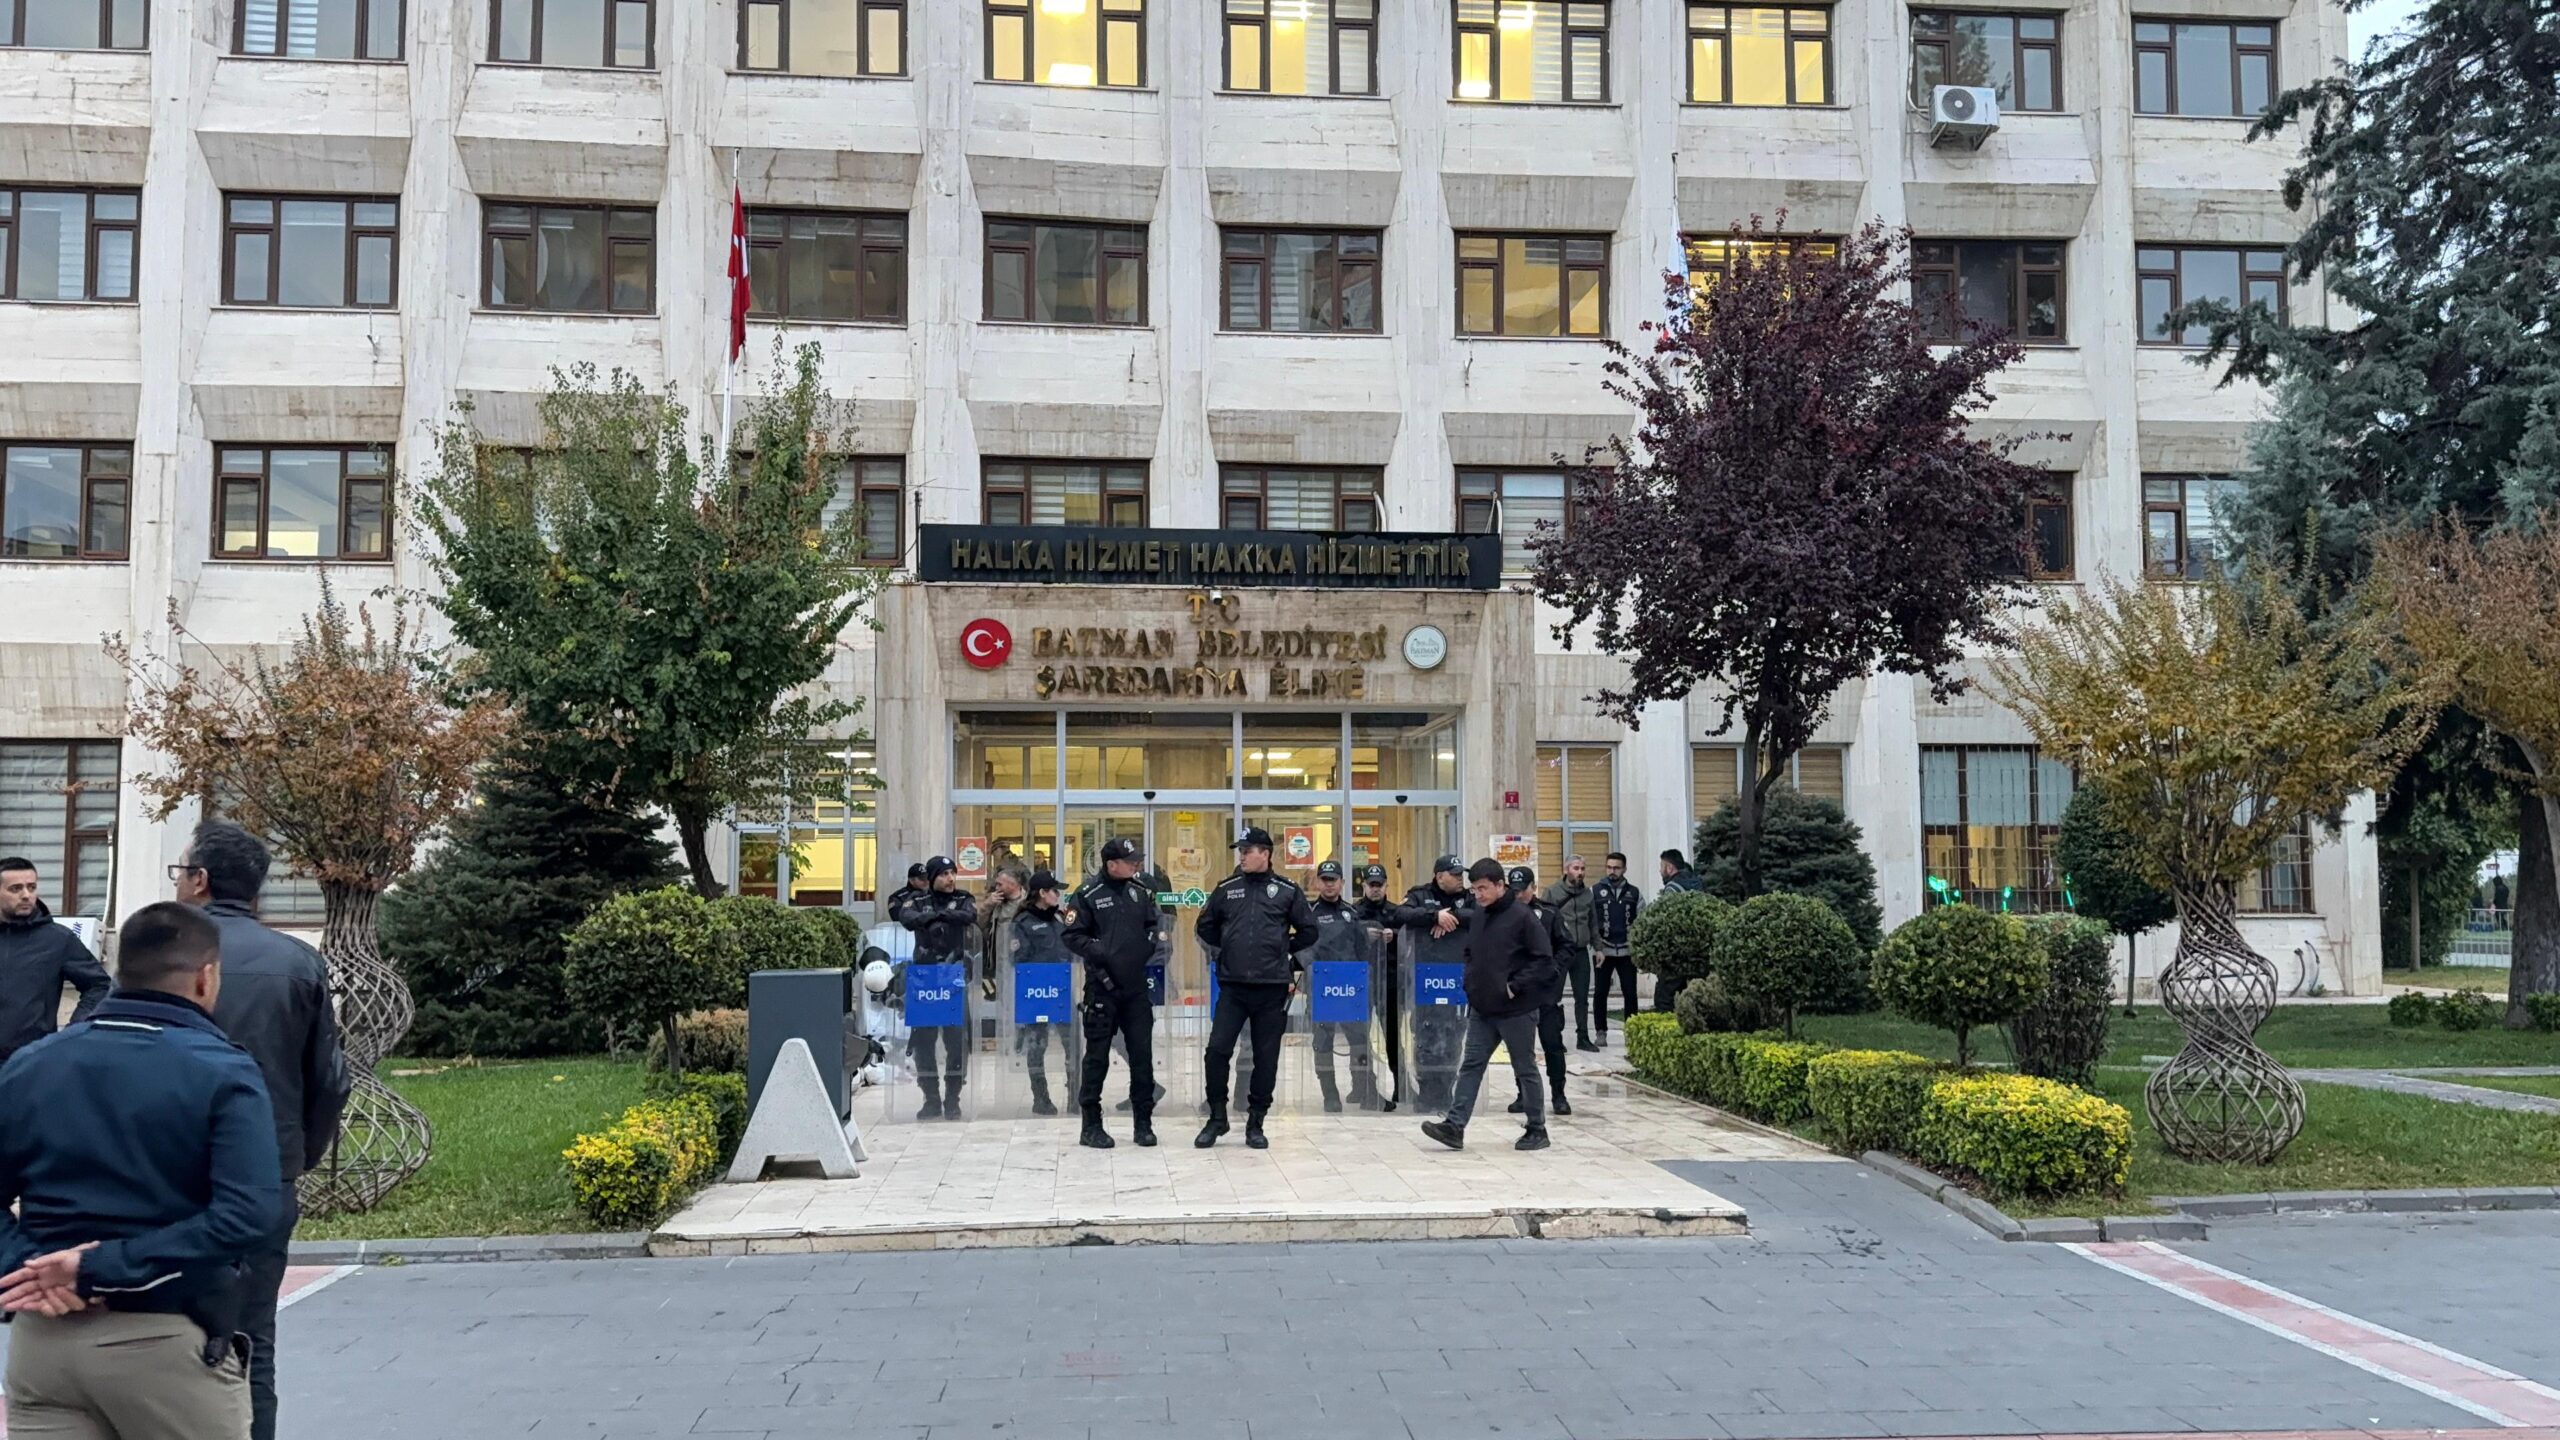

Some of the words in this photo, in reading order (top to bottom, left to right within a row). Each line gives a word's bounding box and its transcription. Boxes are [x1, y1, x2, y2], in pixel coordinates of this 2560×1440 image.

[951, 538, 1054, 570] HALKA
[1064, 533, 1181, 572] HİZMET
[1190, 542, 1297, 574] HAKKA
[1306, 537, 1470, 576] HİZMETTİR
[1032, 626, 1175, 658] BATMAN
[1196, 623, 1388, 662] BELEDİYESİ
[918, 986, 951, 1001] POLİS
[1027, 985, 1059, 999] POLİS
[1324, 983, 1356, 997] POLİS
